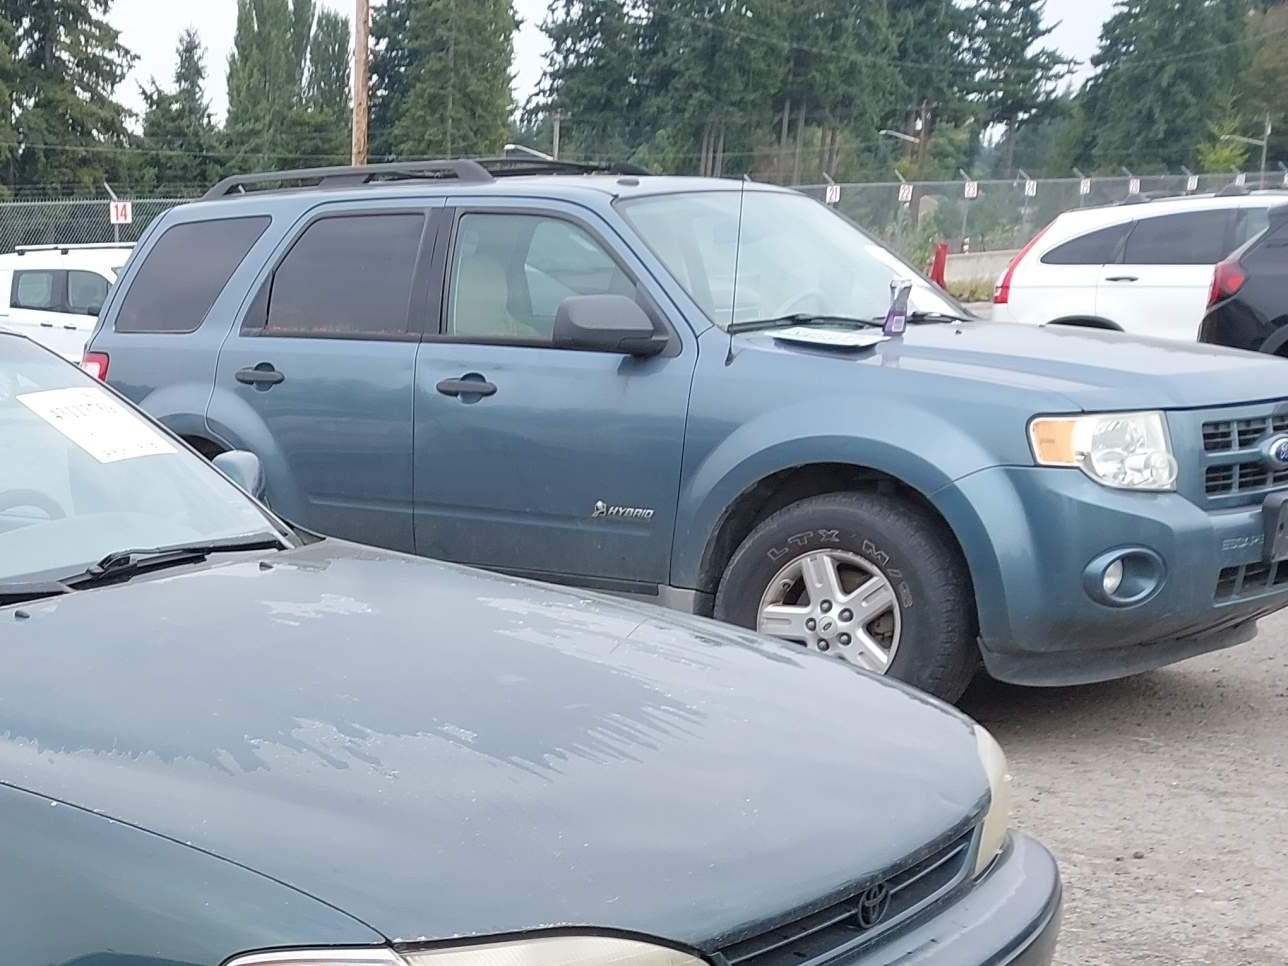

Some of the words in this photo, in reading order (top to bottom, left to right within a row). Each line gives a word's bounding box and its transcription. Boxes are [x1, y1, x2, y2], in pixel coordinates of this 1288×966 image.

[114, 204, 128, 221] 14
[607, 505, 655, 519] HYBRID
[767, 529, 840, 561] LTX
